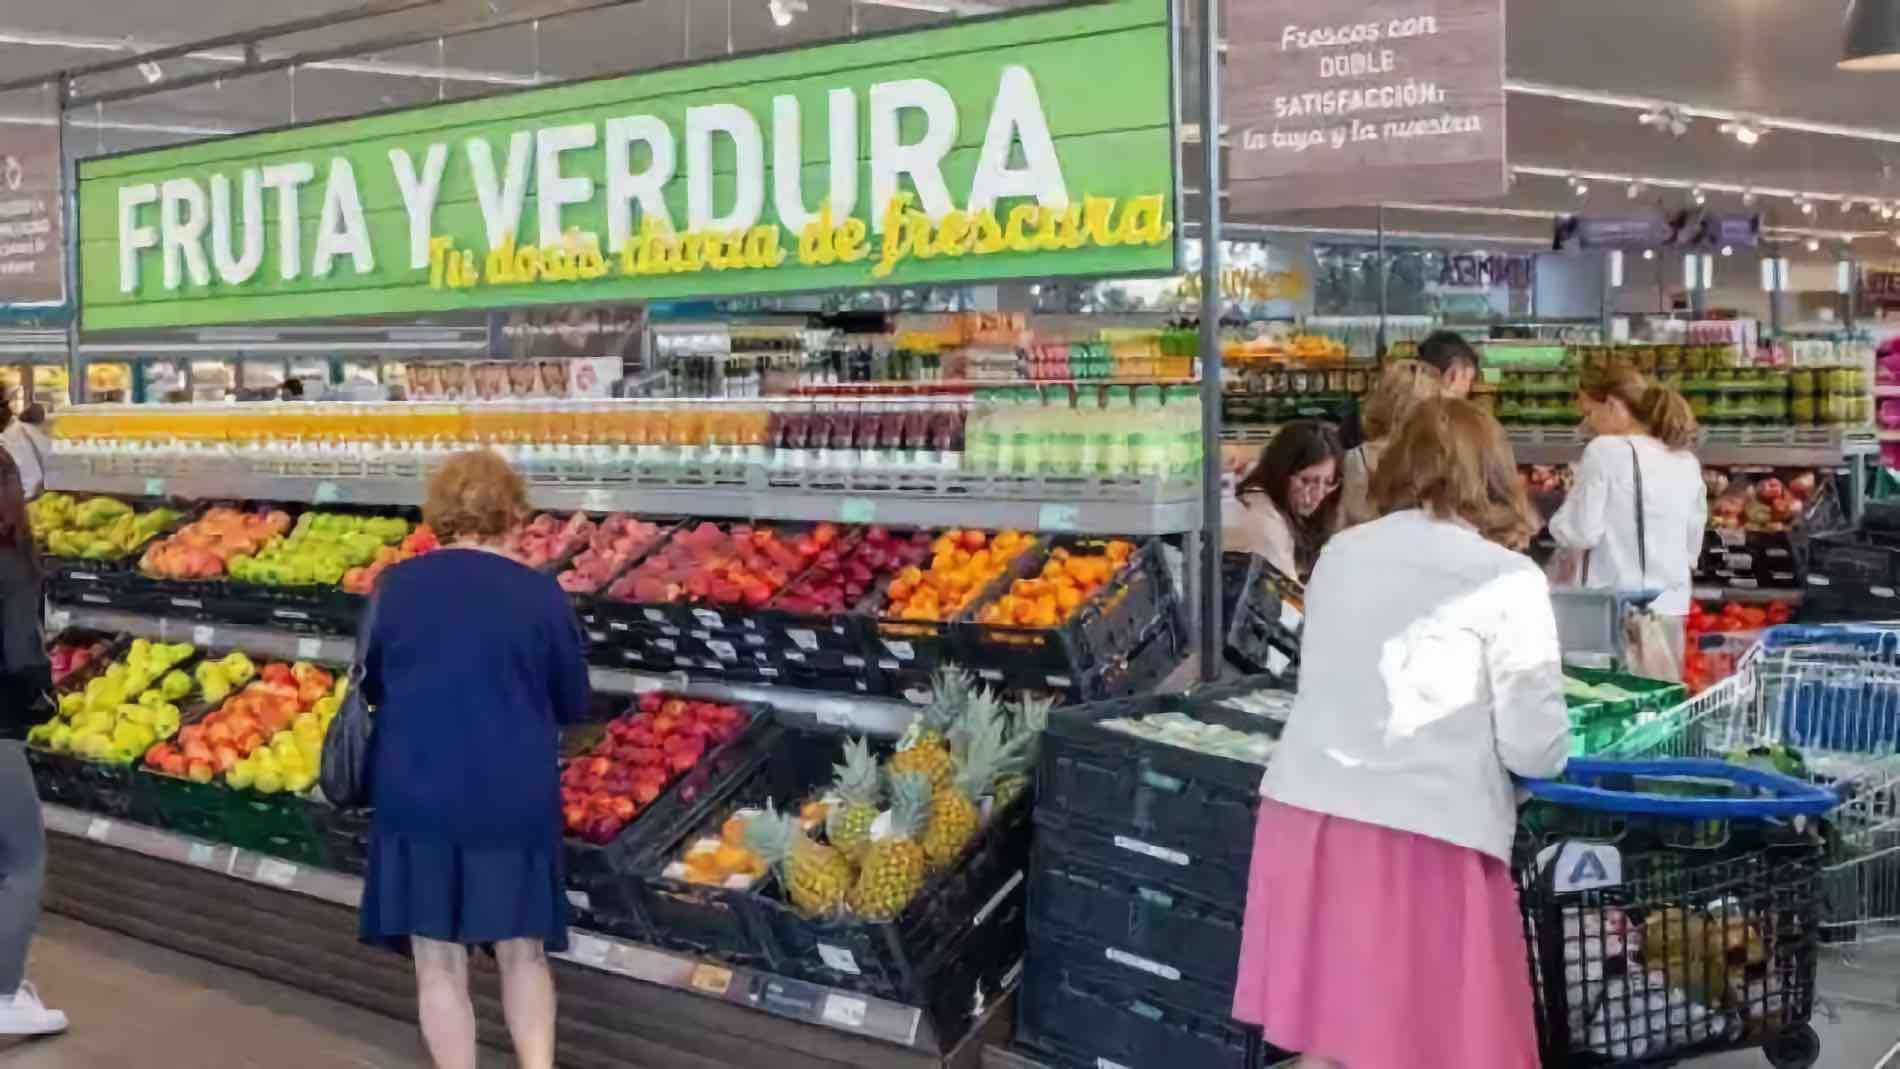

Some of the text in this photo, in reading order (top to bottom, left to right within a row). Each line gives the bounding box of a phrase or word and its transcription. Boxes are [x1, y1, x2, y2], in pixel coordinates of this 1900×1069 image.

[1281, 15, 1438, 51] Frescos con
[1320, 50, 1395, 78] DOBLE
[1272, 125, 1325, 152] tuya
[1331, 126, 1346, 149] y
[1351, 119, 1377, 142] la
[1383, 114, 1481, 140] nuestra
[117, 64, 1071, 294] FRUTA Y VERDURA
[429, 235, 479, 290] Tu
[486, 227, 609, 284] dosis
[799, 199, 870, 265] de
[873, 191, 1173, 279] frescura
